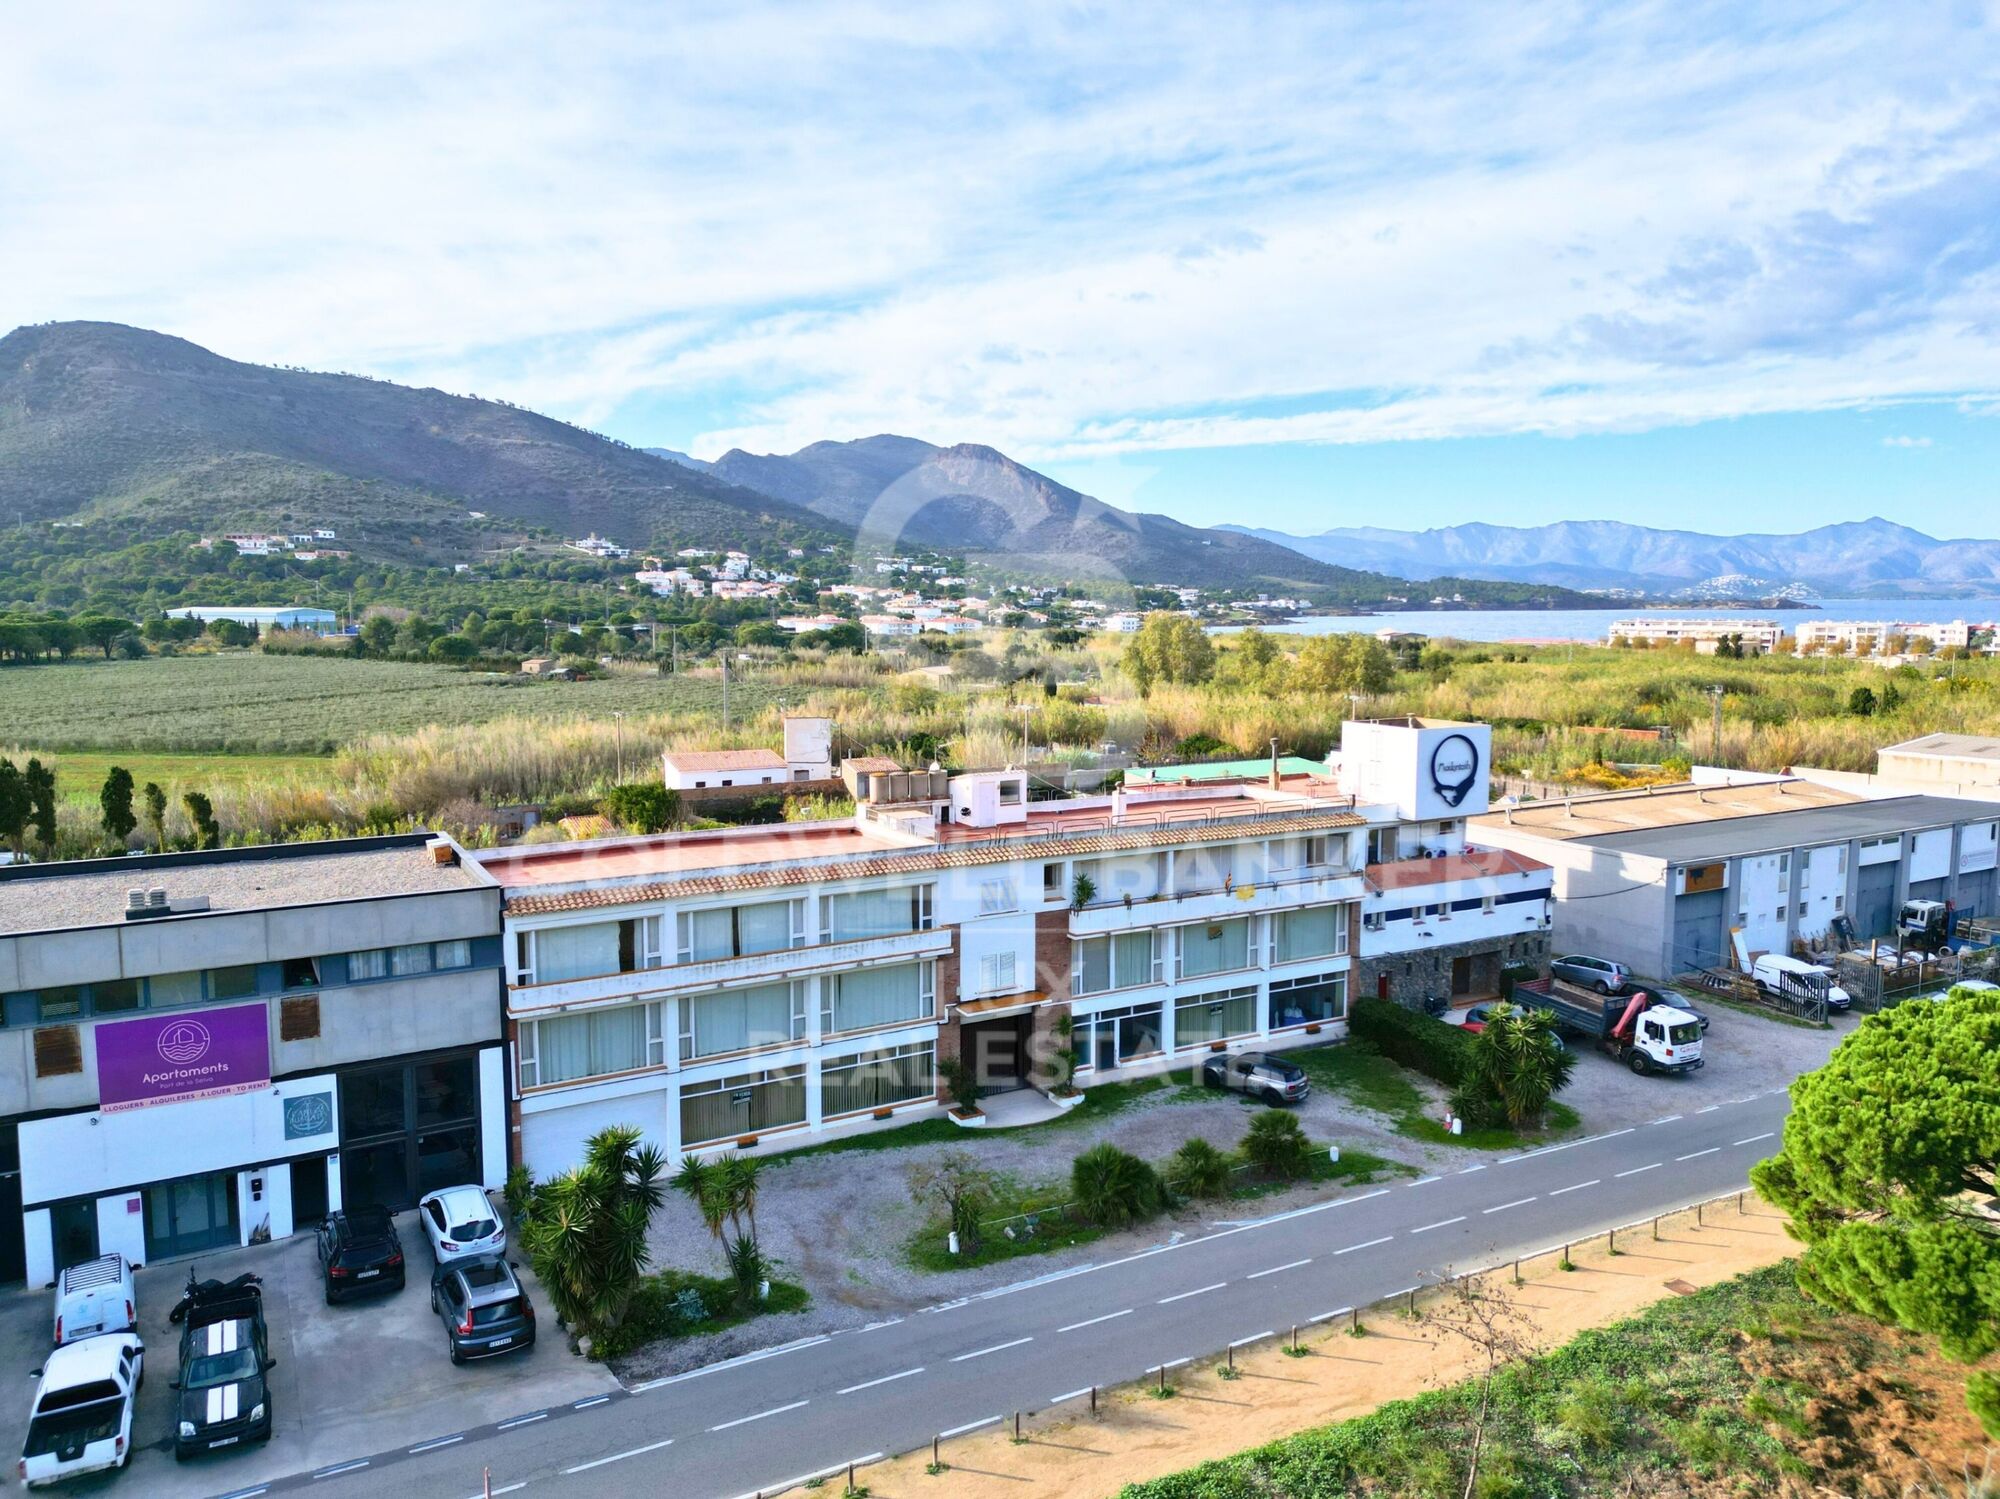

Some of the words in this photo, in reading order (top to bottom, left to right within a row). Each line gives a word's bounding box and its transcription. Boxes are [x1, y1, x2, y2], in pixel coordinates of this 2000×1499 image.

[142, 1062, 229, 1084] Apartaments
[160, 1081, 174, 1089] Port
[195, 1077, 213, 1085] Selva
[104, 1101, 144, 1112] LLOGUERS
[150, 1094, 195, 1105] ALQUILERES
[207, 1088, 231, 1097] LOUER
[237, 1085, 246, 1093] TO
[248, 1082, 267, 1091] RENT
